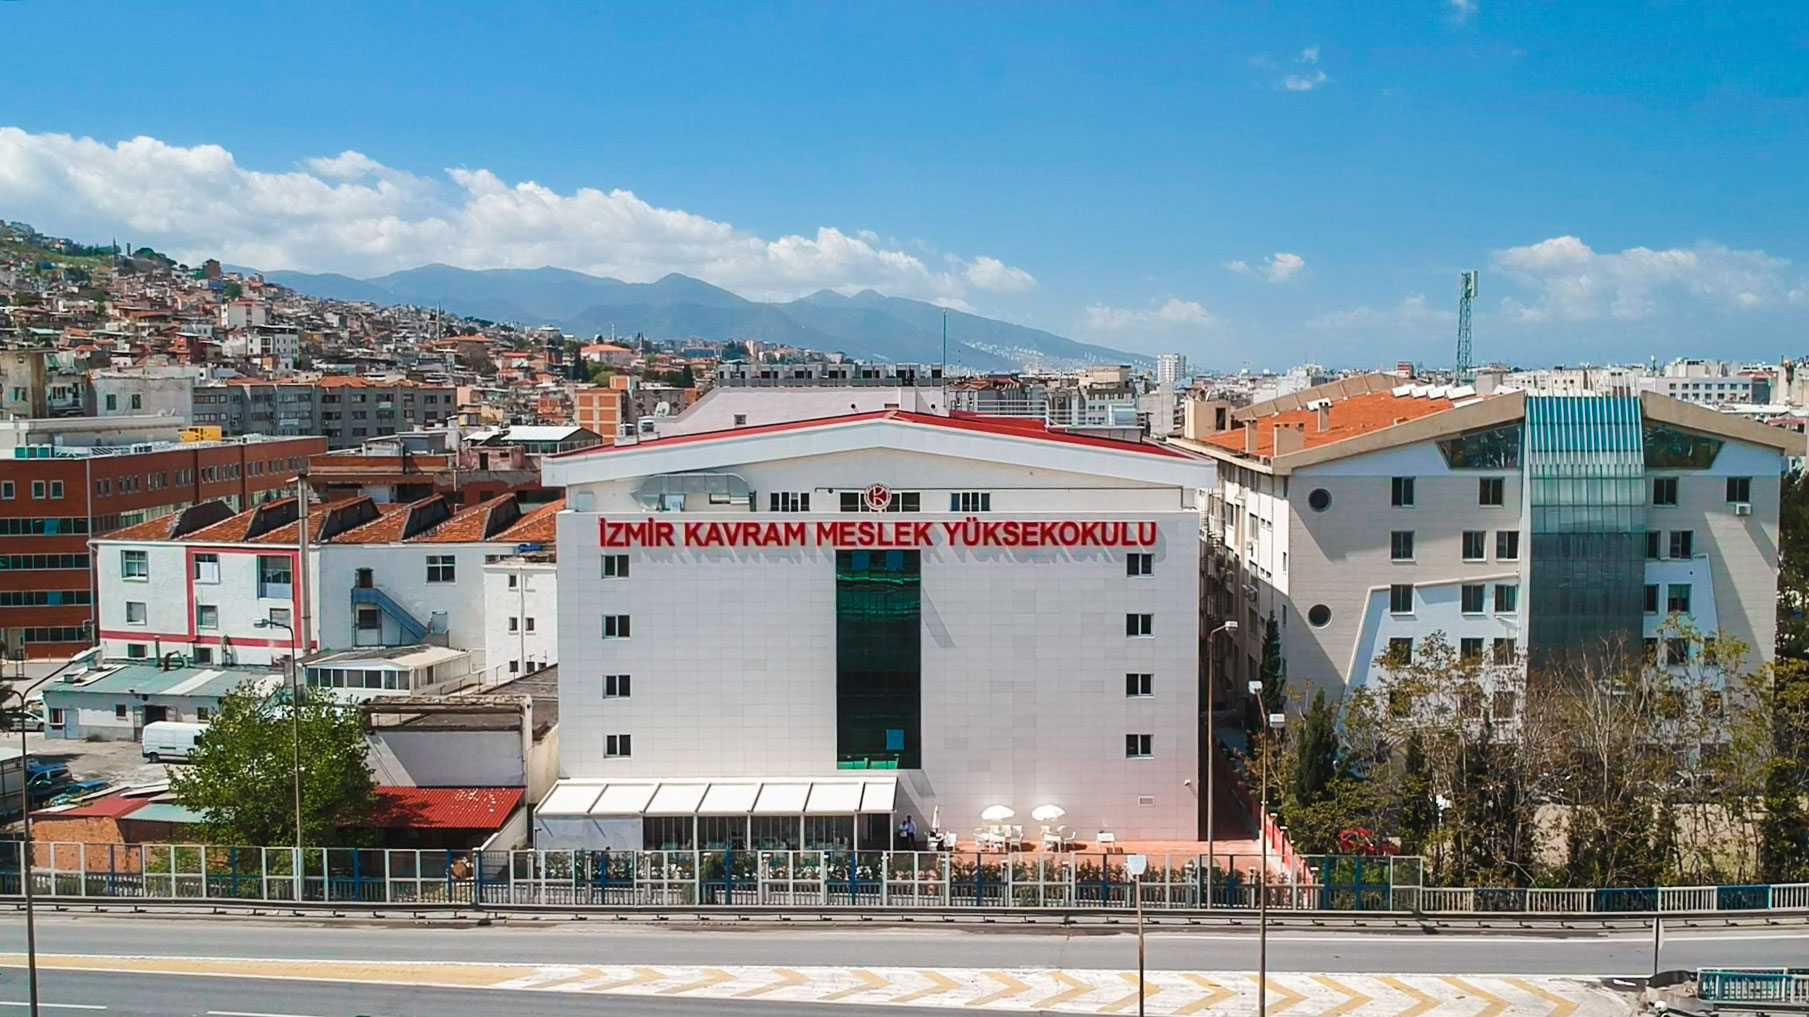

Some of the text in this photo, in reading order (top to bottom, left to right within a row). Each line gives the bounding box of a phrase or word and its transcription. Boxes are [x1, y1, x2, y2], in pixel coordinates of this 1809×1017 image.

[599, 516, 1157, 547] İZMİR KAVRAM MESLEK YÜKSEKOKULU
